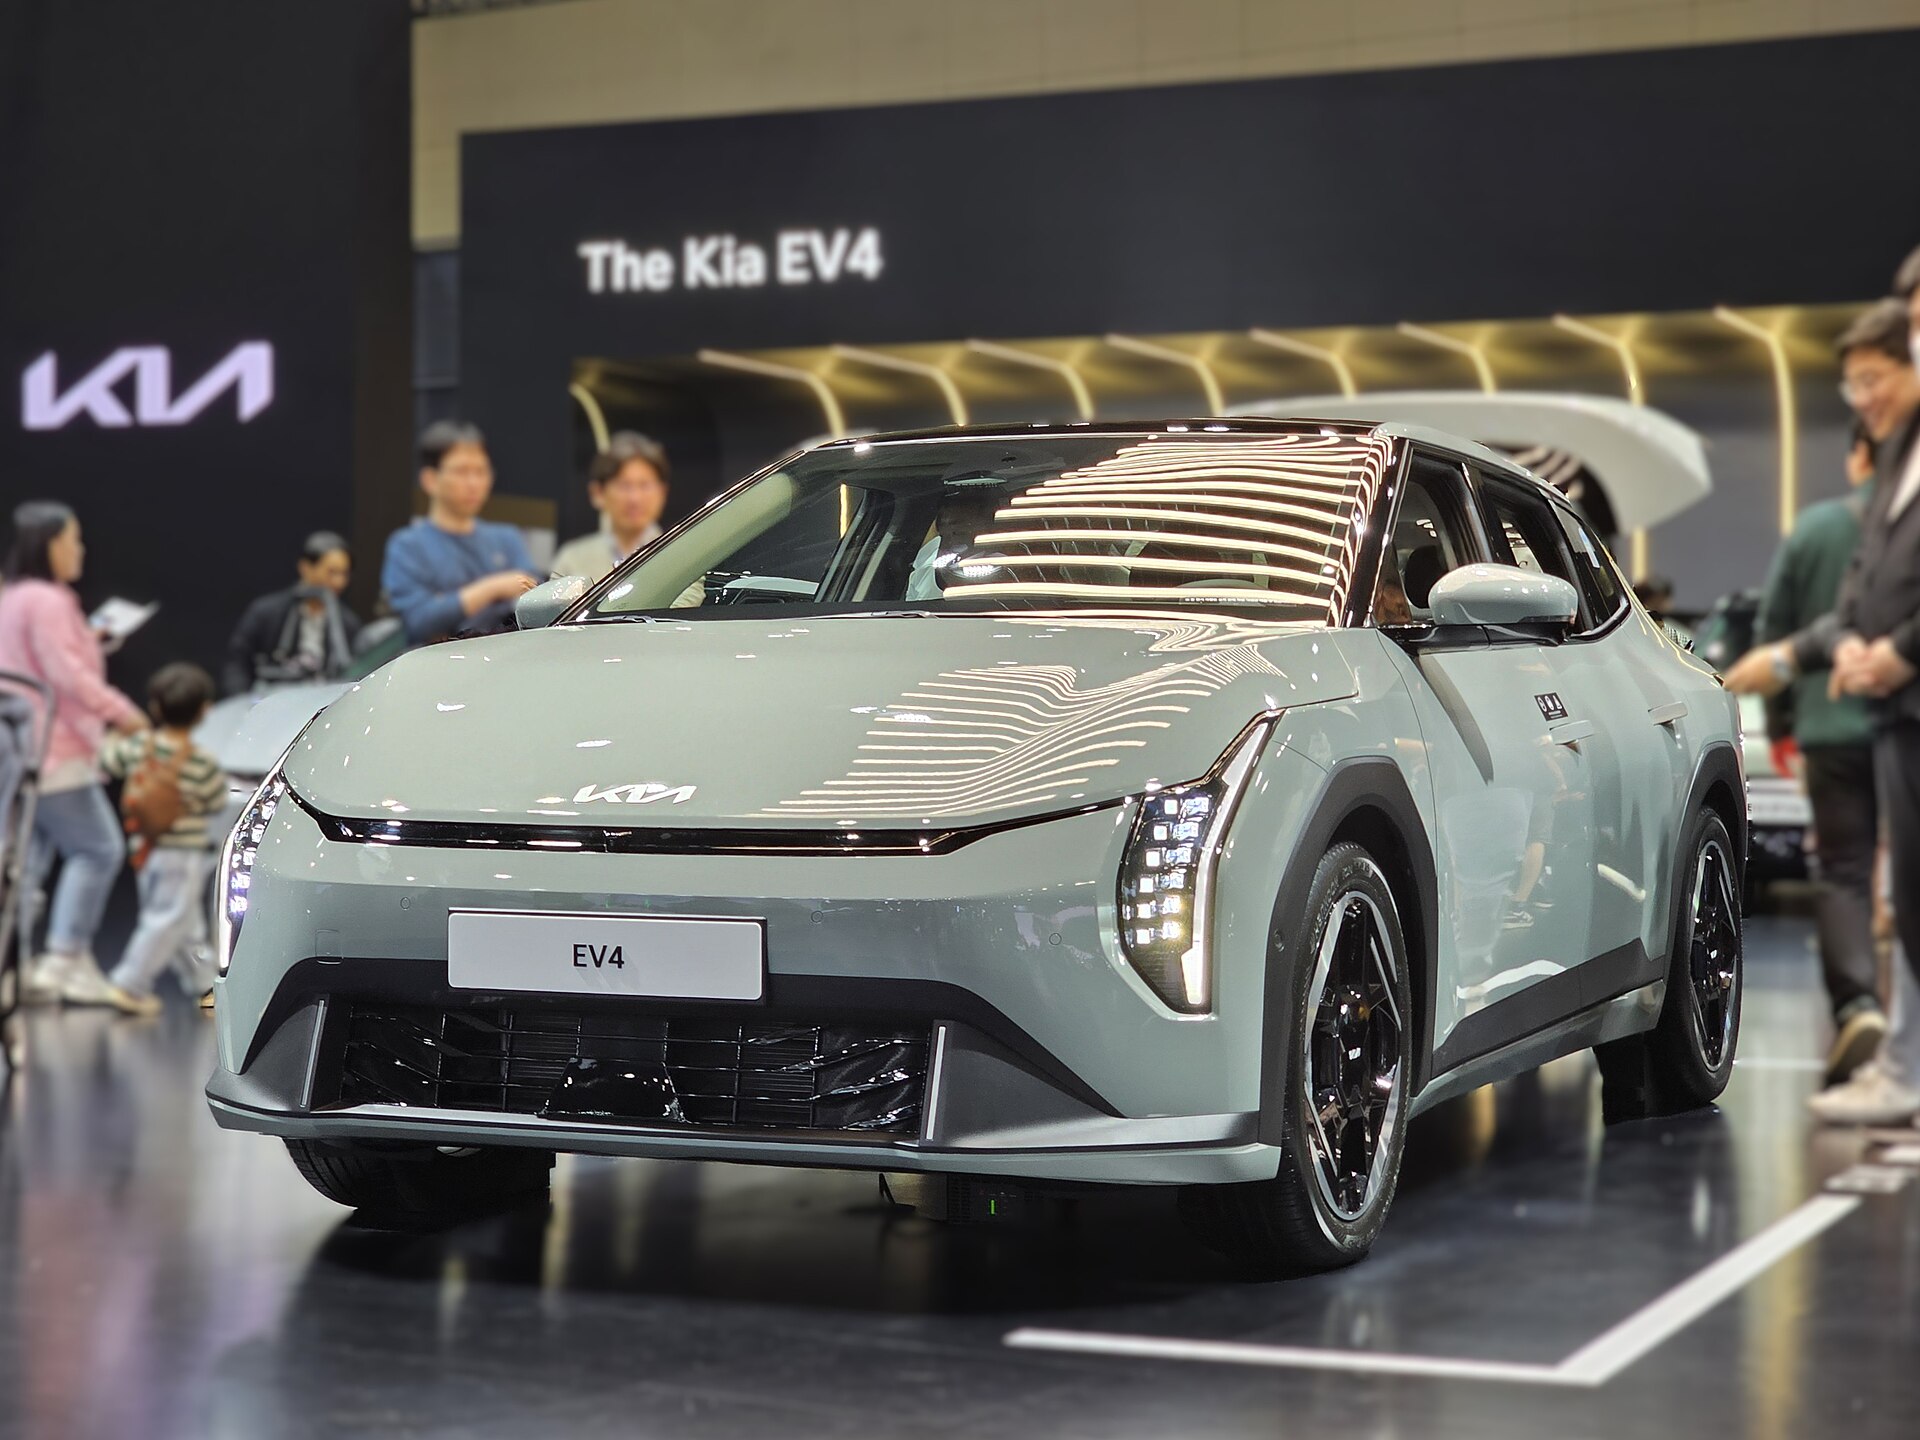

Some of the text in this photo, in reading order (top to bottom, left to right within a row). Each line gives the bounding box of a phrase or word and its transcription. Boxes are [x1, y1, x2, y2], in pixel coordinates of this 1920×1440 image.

[579, 227, 884, 293] The Kia EV4
[22, 341, 274, 430] KIA
[572, 783, 697, 804] KIA
[573, 943, 625, 970] EV4
